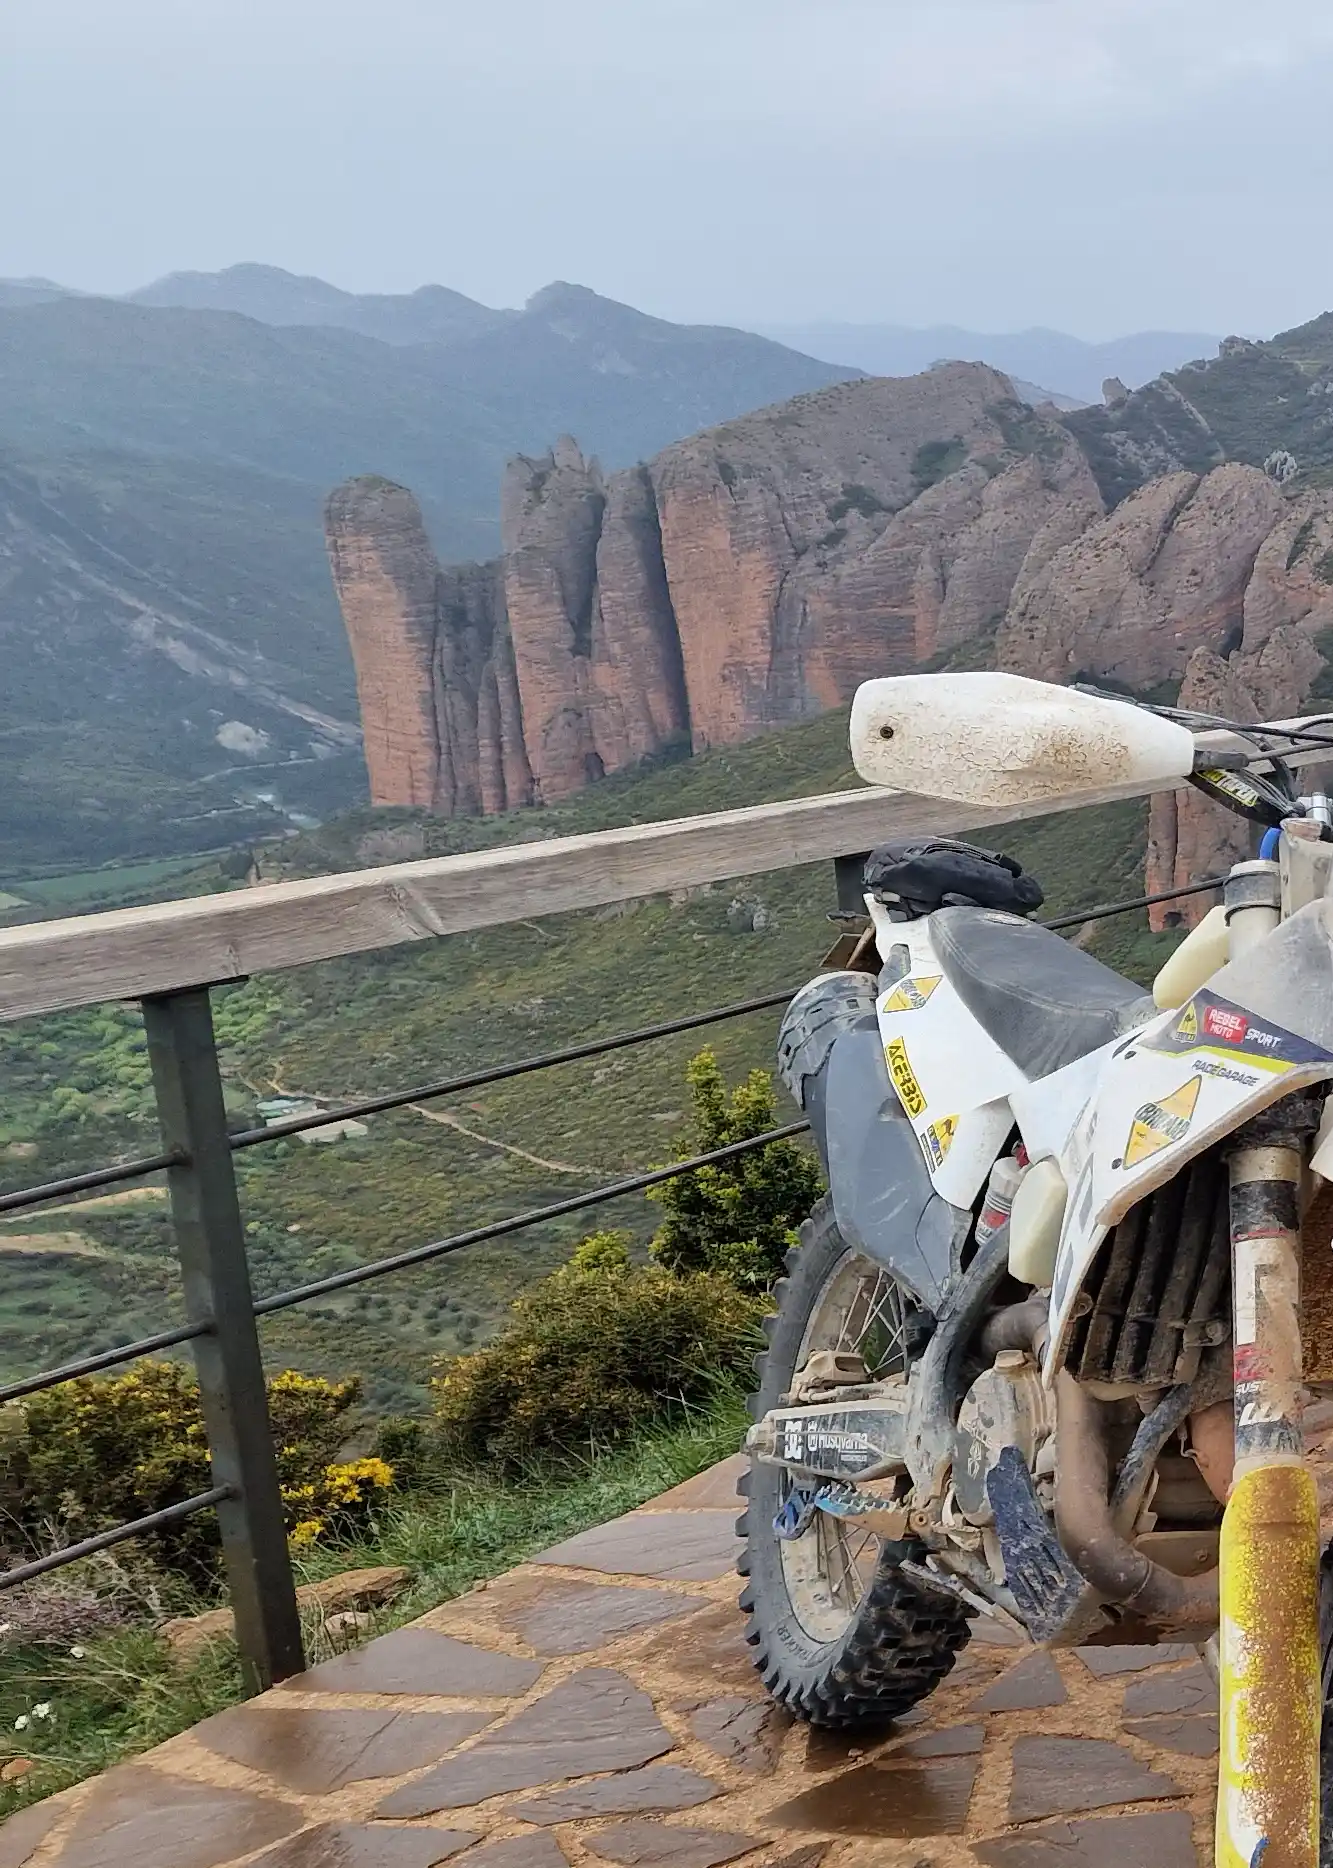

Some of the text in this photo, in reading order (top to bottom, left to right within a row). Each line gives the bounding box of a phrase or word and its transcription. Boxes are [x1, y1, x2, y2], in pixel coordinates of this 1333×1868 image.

[1208, 1008, 1242, 1032] REBEL
[1209, 1021, 1234, 1040] MOTO
[1244, 1026, 1282, 1050] SPORT
